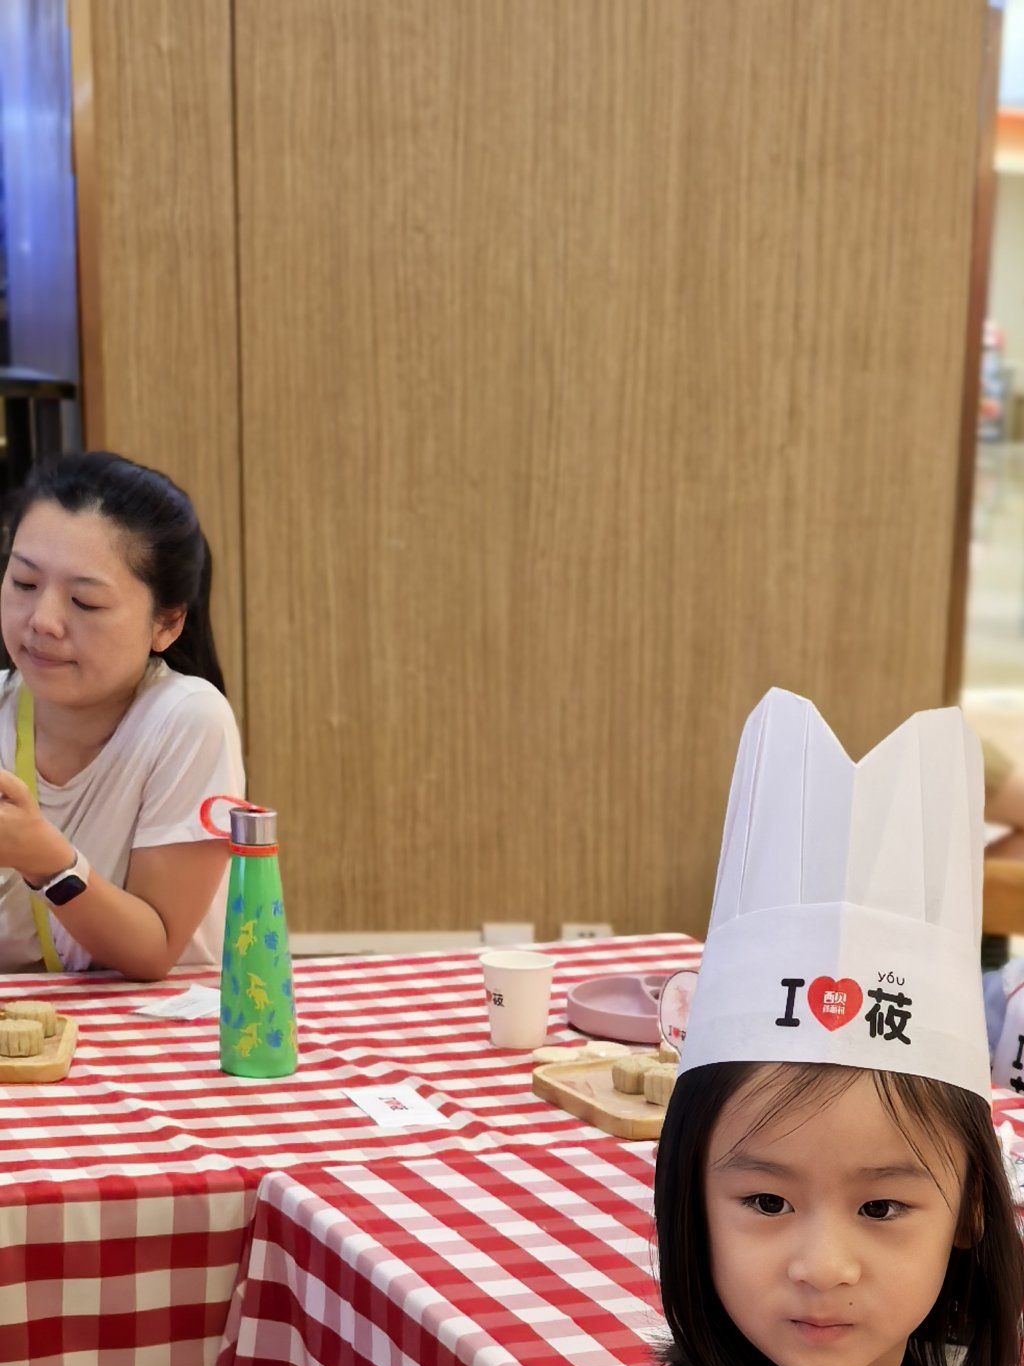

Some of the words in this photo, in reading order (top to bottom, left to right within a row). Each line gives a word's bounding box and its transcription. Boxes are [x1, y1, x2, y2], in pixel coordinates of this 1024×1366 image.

[775, 978, 805, 1027] I
[865, 987, 912, 1045] 莜
[823, 990, 846, 1006] 西贝
